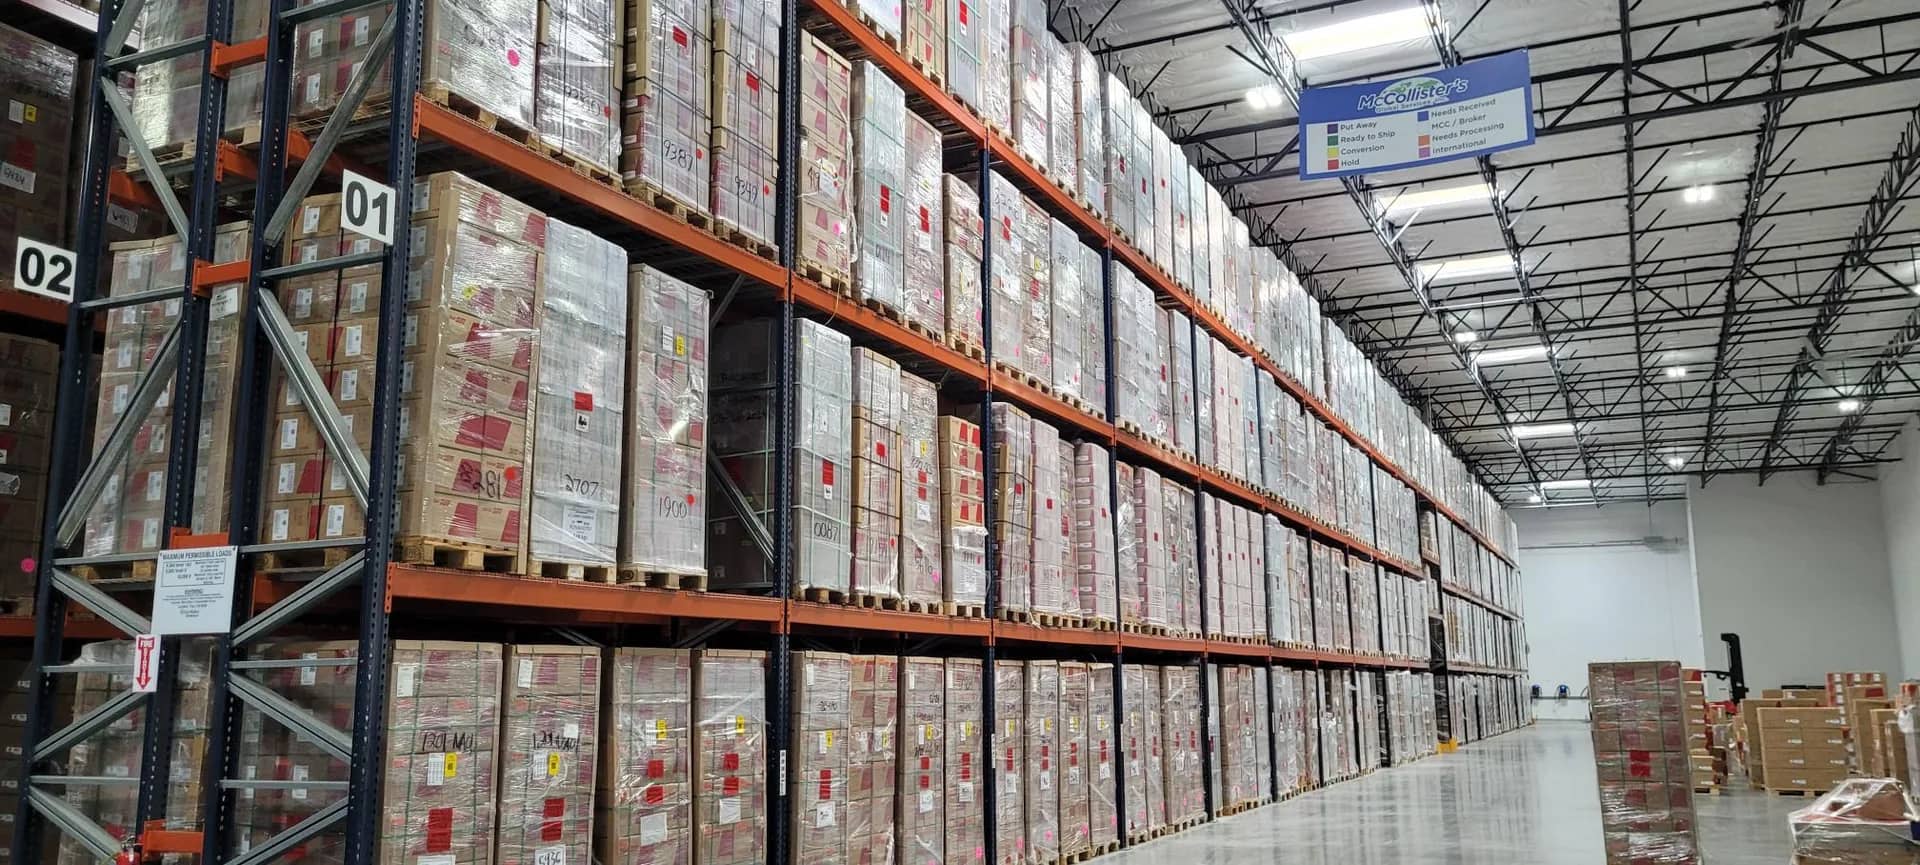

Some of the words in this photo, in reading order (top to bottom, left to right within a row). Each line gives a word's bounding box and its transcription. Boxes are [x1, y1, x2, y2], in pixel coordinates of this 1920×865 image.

[1358, 78, 1468, 110] McCollister's
[1431, 107, 1456, 117] Needs
[1459, 99, 1496, 112] Received
[1432, 121, 1450, 130] MCC
[1459, 114, 1486, 125] Broker
[1432, 132, 1458, 141] Needs
[1460, 122, 1504, 137] Processing
[1340, 134, 1365, 142] Ready
[1378, 130, 1396, 138] Ship
[1340, 145, 1385, 155] Conversion
[1432, 138, 1486, 154] International
[664, 140, 694, 172] 9387
[1341, 158, 1360, 167] Hold
[346, 181, 388, 236] 01
[20, 247, 72, 296] 02
[565, 474, 599, 497] 2707
[659, 496, 687, 519] 1900
